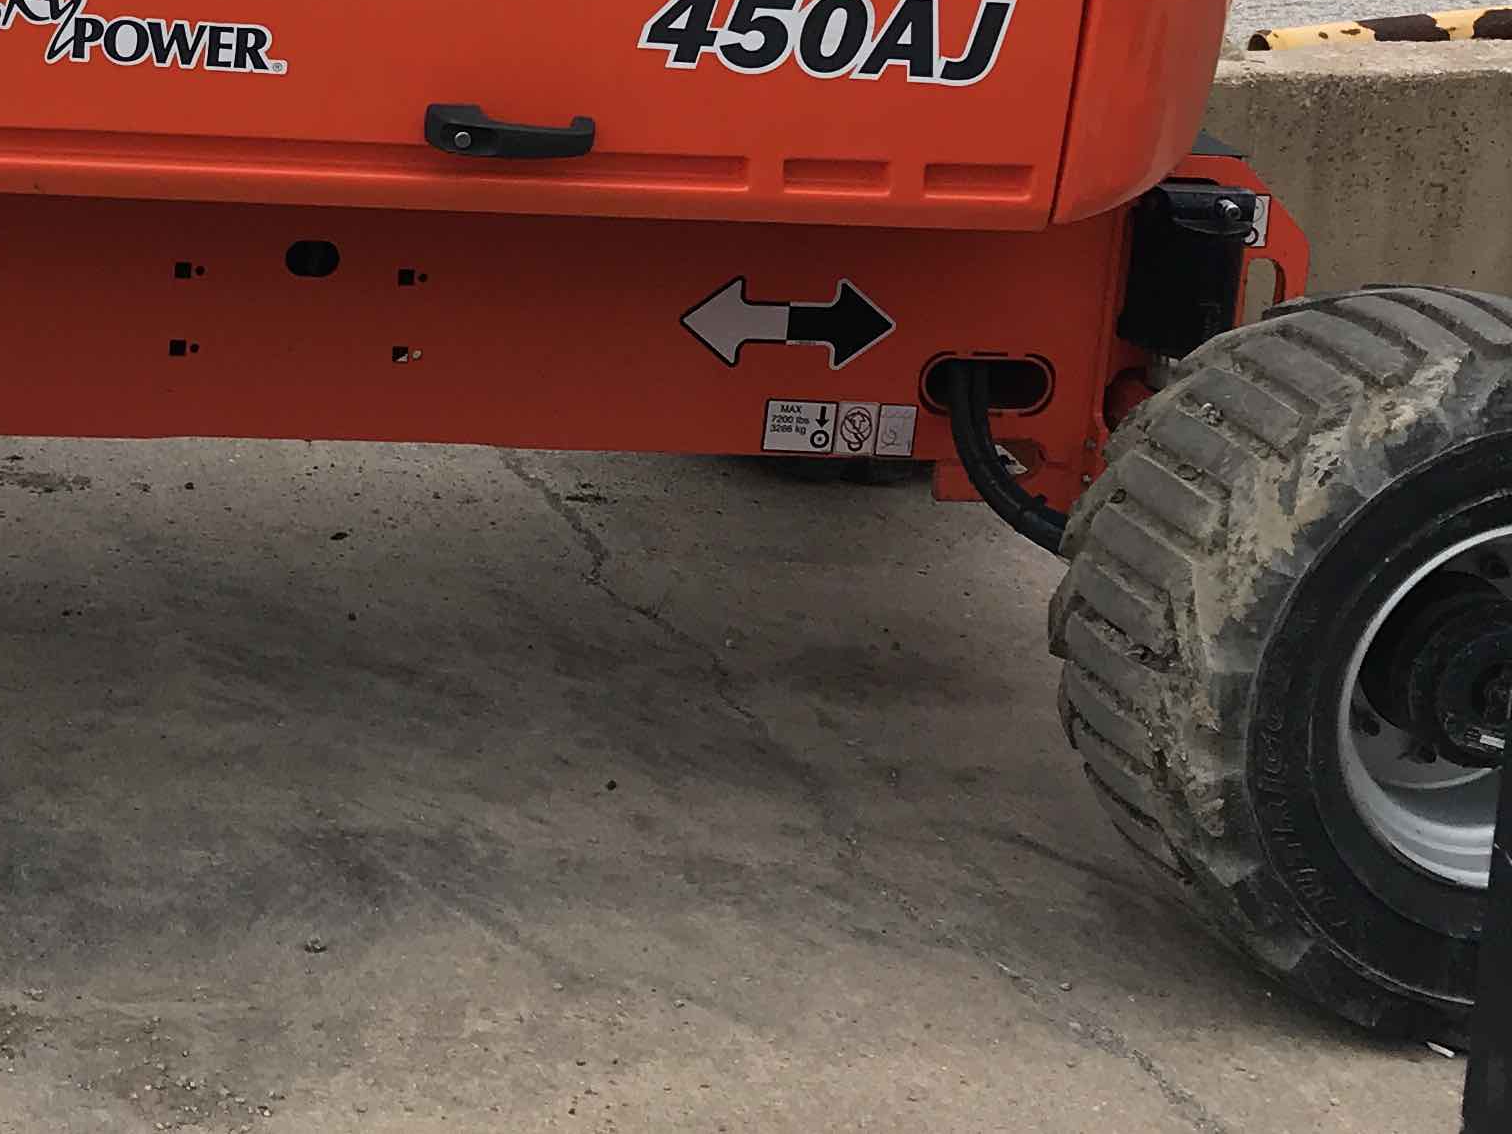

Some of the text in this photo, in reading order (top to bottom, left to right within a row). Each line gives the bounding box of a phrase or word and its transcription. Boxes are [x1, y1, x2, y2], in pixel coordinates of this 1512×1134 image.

[780, 405, 802, 414] MAX
[770, 414, 810, 425] 7200 lbs
[795, 425, 807, 436] kg
